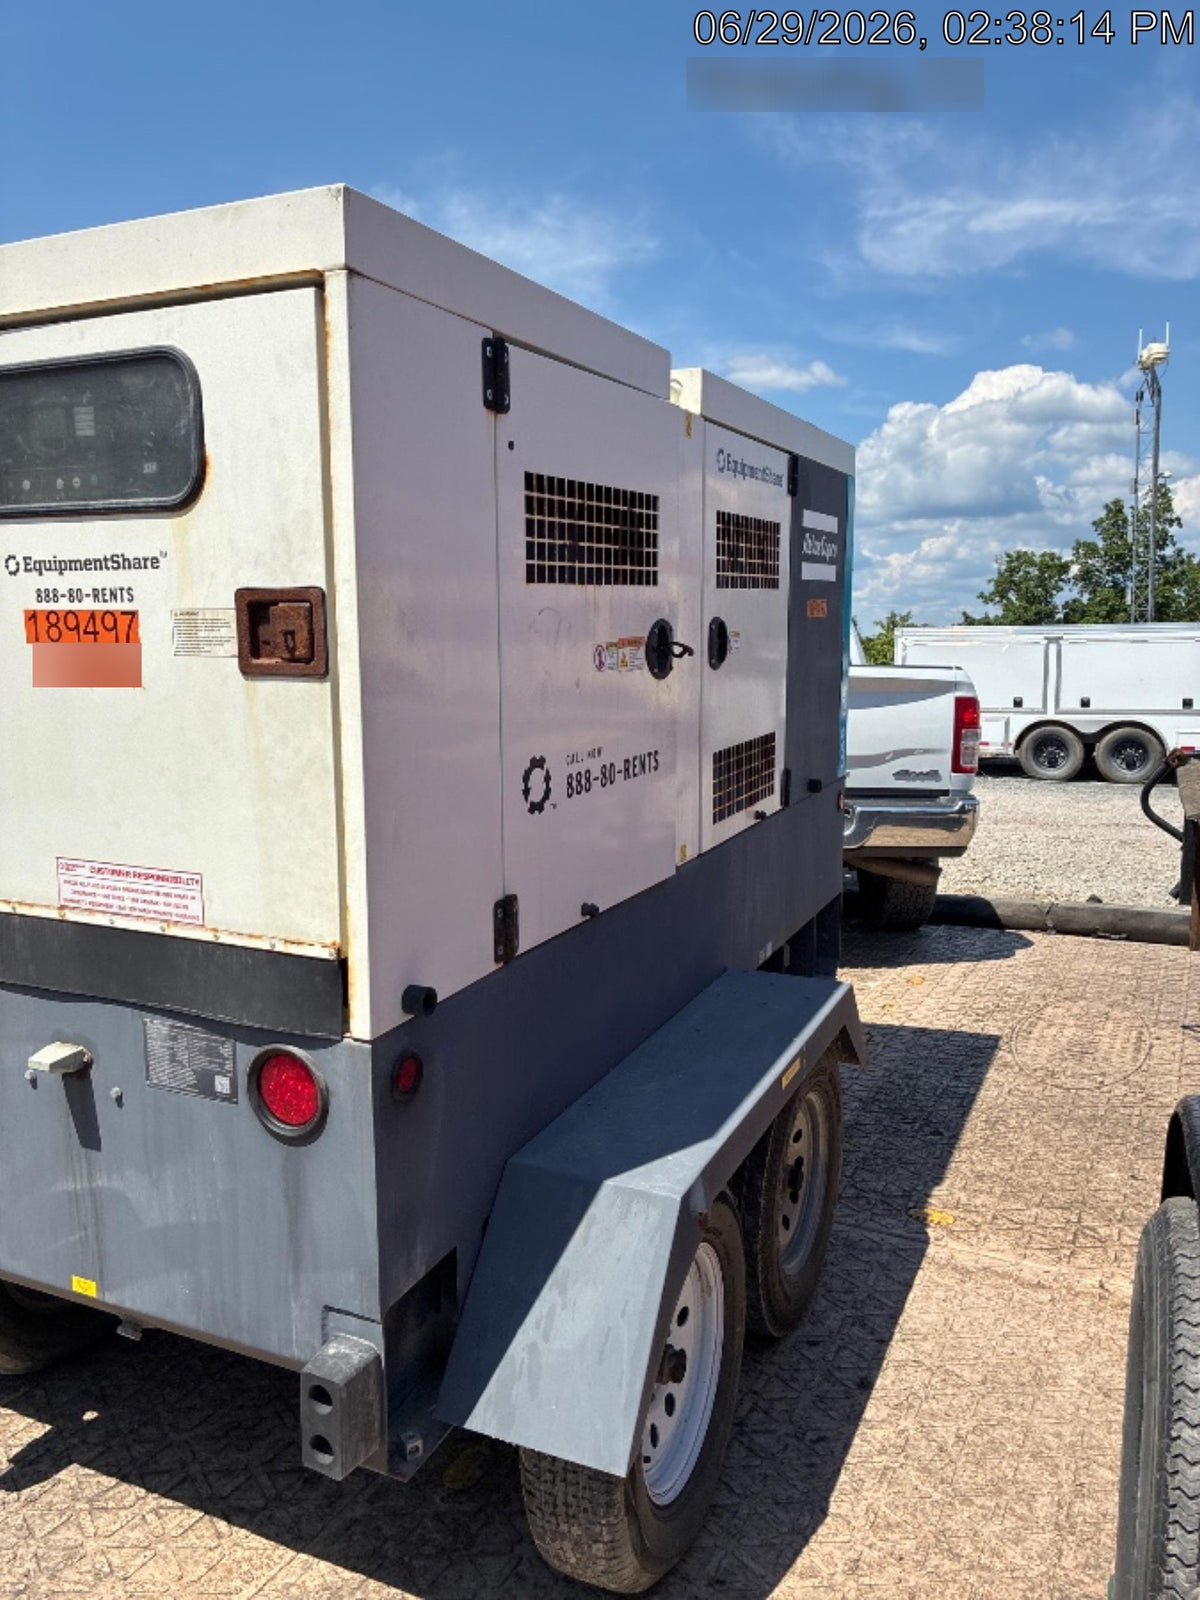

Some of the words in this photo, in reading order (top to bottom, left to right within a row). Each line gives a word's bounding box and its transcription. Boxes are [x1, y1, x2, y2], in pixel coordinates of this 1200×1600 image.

[22, 553, 161, 576] EquipmentShare
[35, 587, 134, 604] 888-80-RENTS
[27, 609, 137, 644] 189497
[566, 749, 660, 799] 888-80-RENTS
